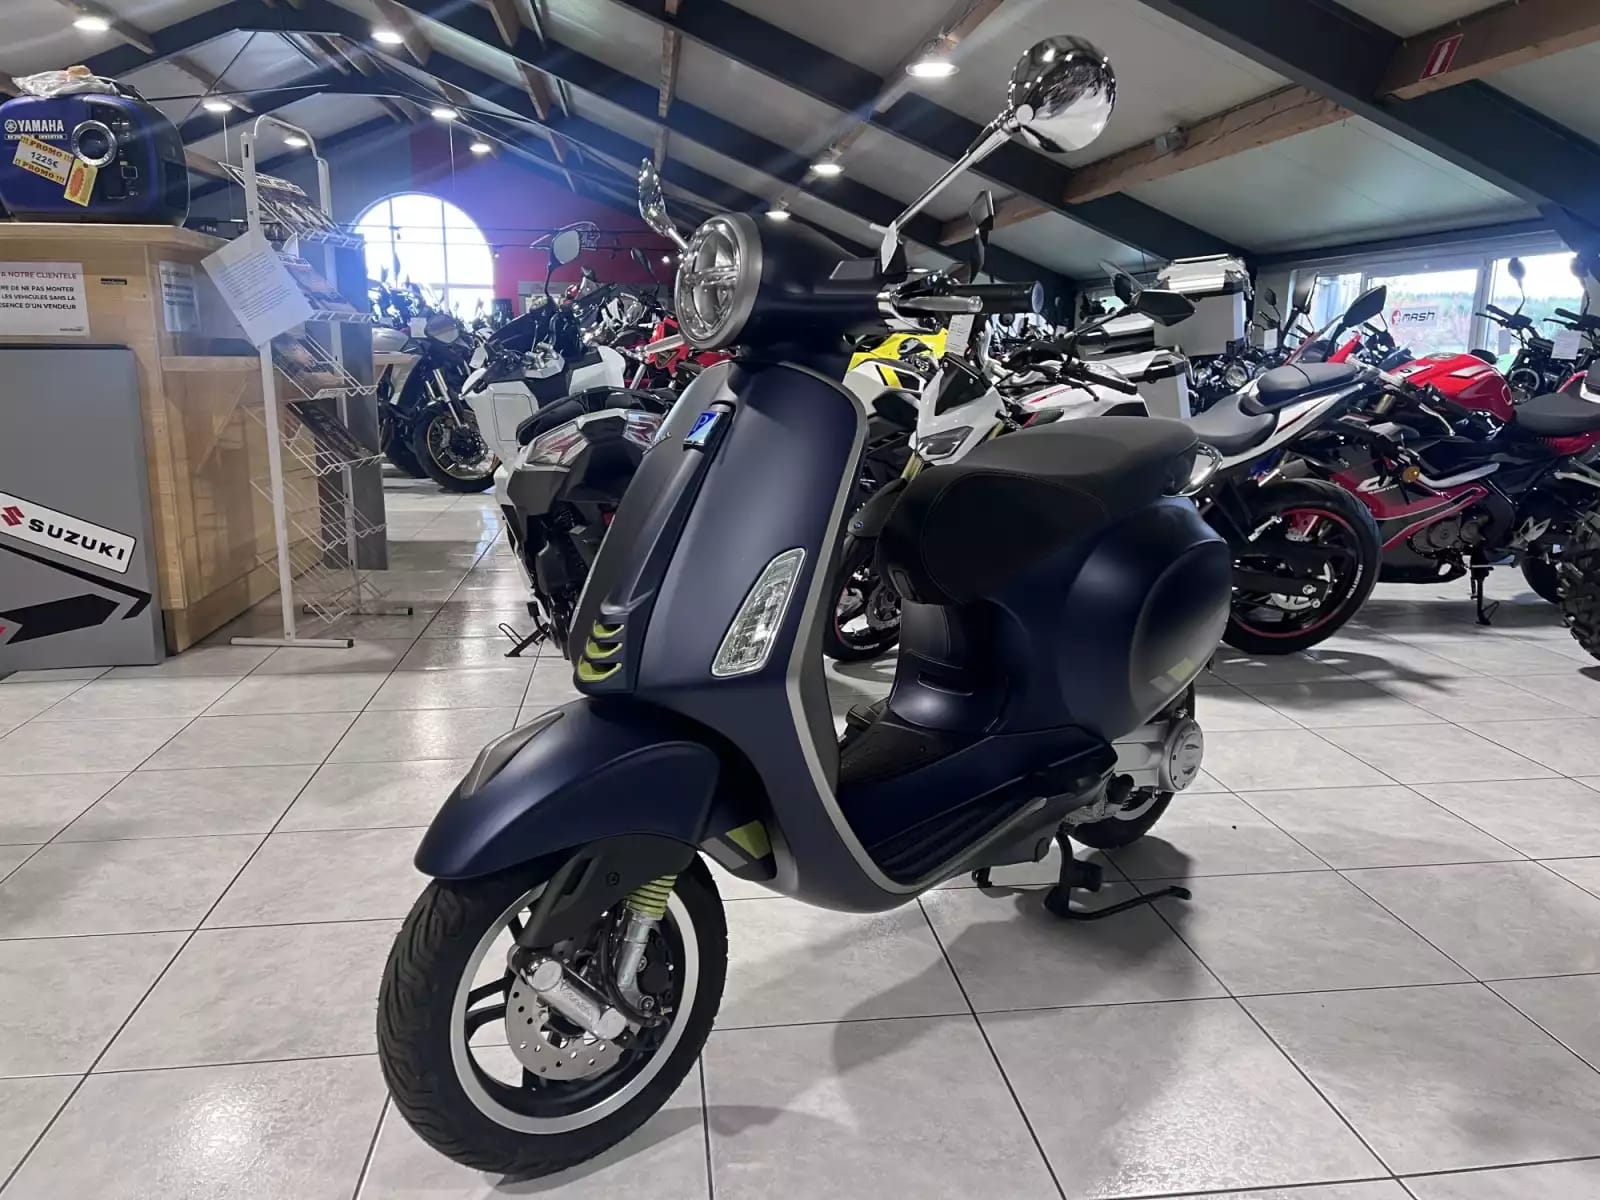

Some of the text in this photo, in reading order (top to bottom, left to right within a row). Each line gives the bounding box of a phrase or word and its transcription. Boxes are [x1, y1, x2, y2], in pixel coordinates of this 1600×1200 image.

[17, 119, 65, 132] YAMAHA
[30, 140, 63, 158] PROMO
[22, 161, 55, 179] PROMO
[8, 271, 35, 279] NOTRE
[36, 272, 77, 280] CLIENTELE
[28, 518, 125, 561] SUZUKI
